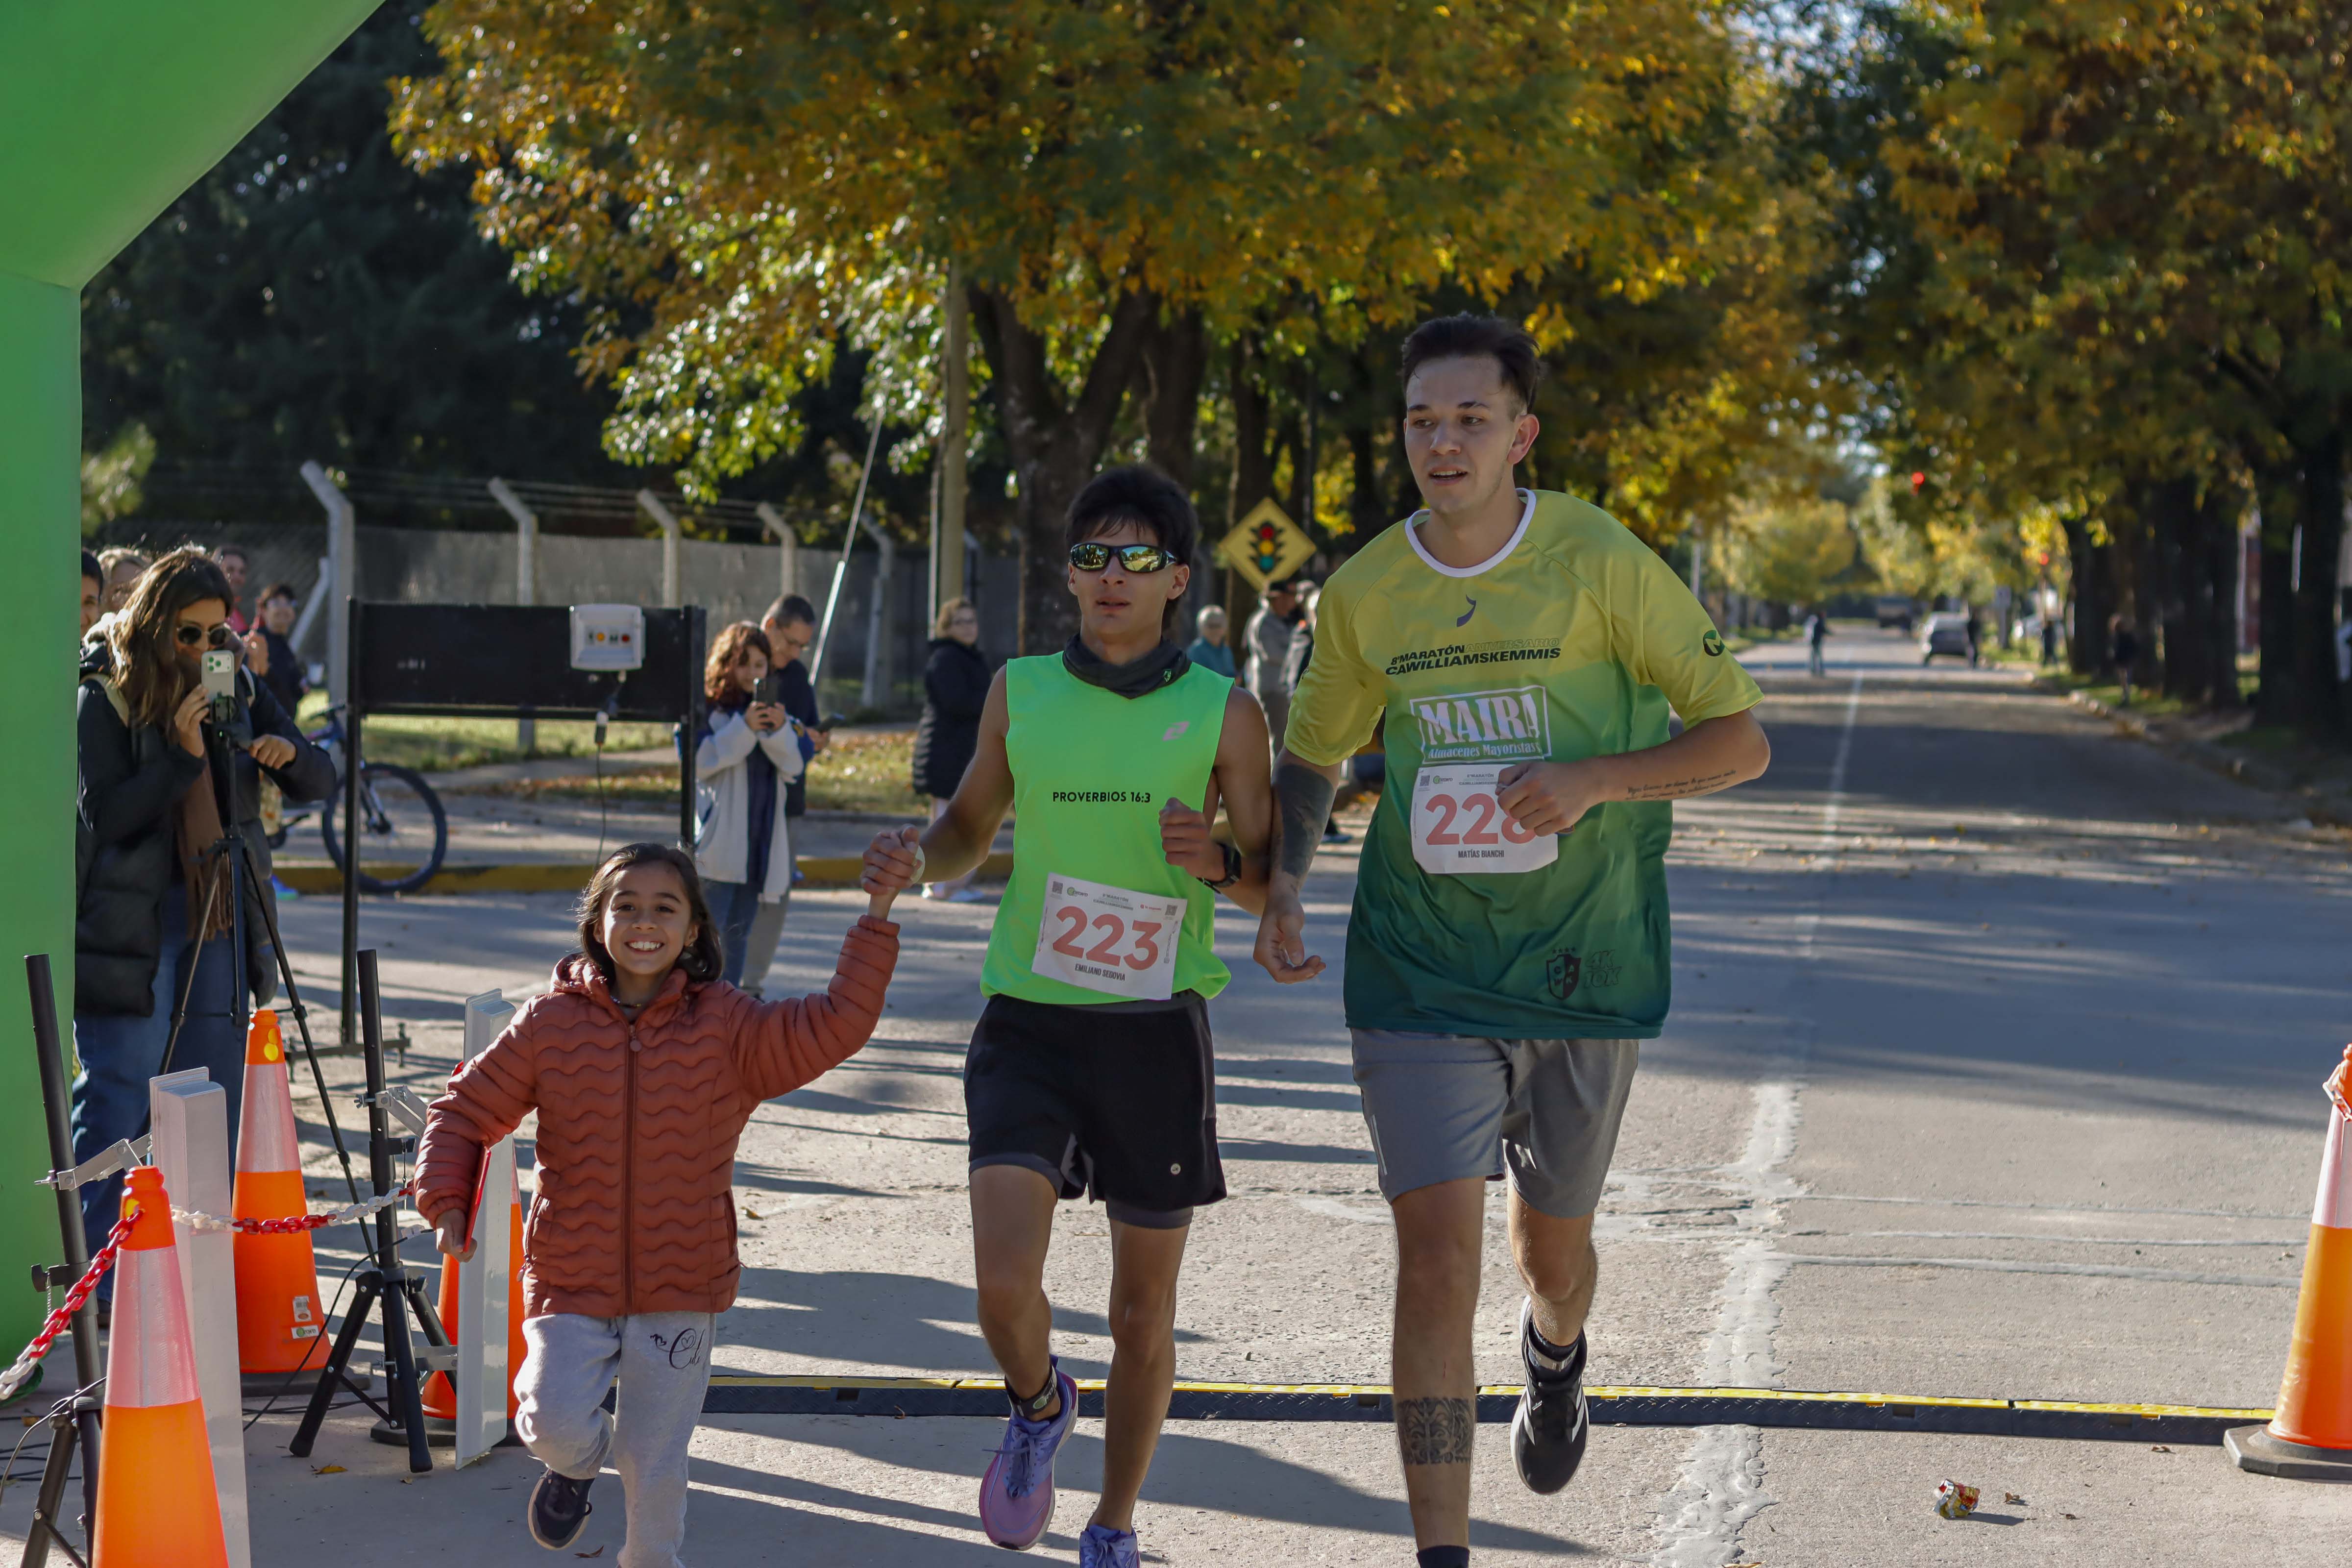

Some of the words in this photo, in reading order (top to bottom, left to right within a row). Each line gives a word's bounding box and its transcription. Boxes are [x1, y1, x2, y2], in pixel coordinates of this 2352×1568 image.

[1385, 647, 1561, 675] CAWILLIAMSKEMMIS
[1419, 693, 1540, 745] MAIRA
[1428, 746, 1480, 759] Almacenes
[1053, 791, 1127, 803] PROVERBIOS
[1130, 791, 1152, 803] 16:3
[1458, 849, 1480, 858] MATÍAS
[1481, 850, 1505, 858] BIANCHI
[1053, 906, 1162, 971] 223
[1075, 963, 1102, 976] EMILIANO
[1102, 969, 1126, 981] SEGOVIA
